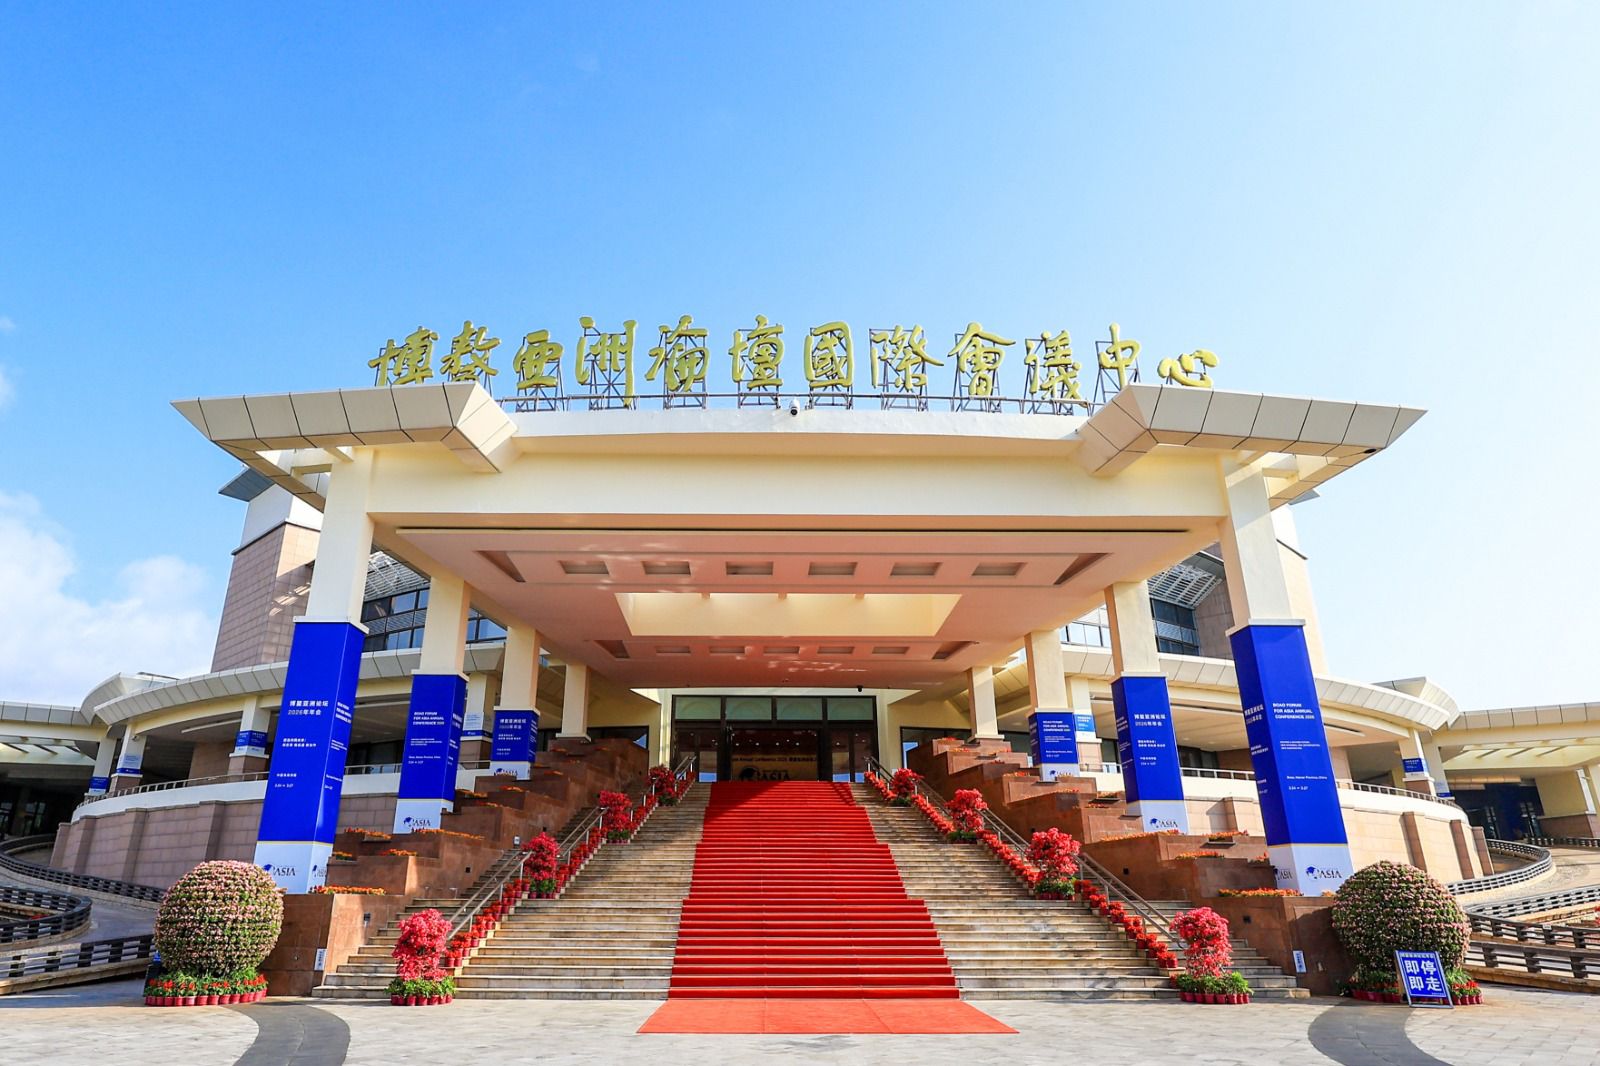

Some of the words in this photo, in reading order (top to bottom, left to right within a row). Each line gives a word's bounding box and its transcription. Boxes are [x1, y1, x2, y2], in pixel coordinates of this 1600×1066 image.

[273, 867, 296, 877] ASIA
[1320, 869, 1342, 879] ASIA
[1404, 960, 1437, 975] 即停
[1408, 976, 1442, 991] 即走
